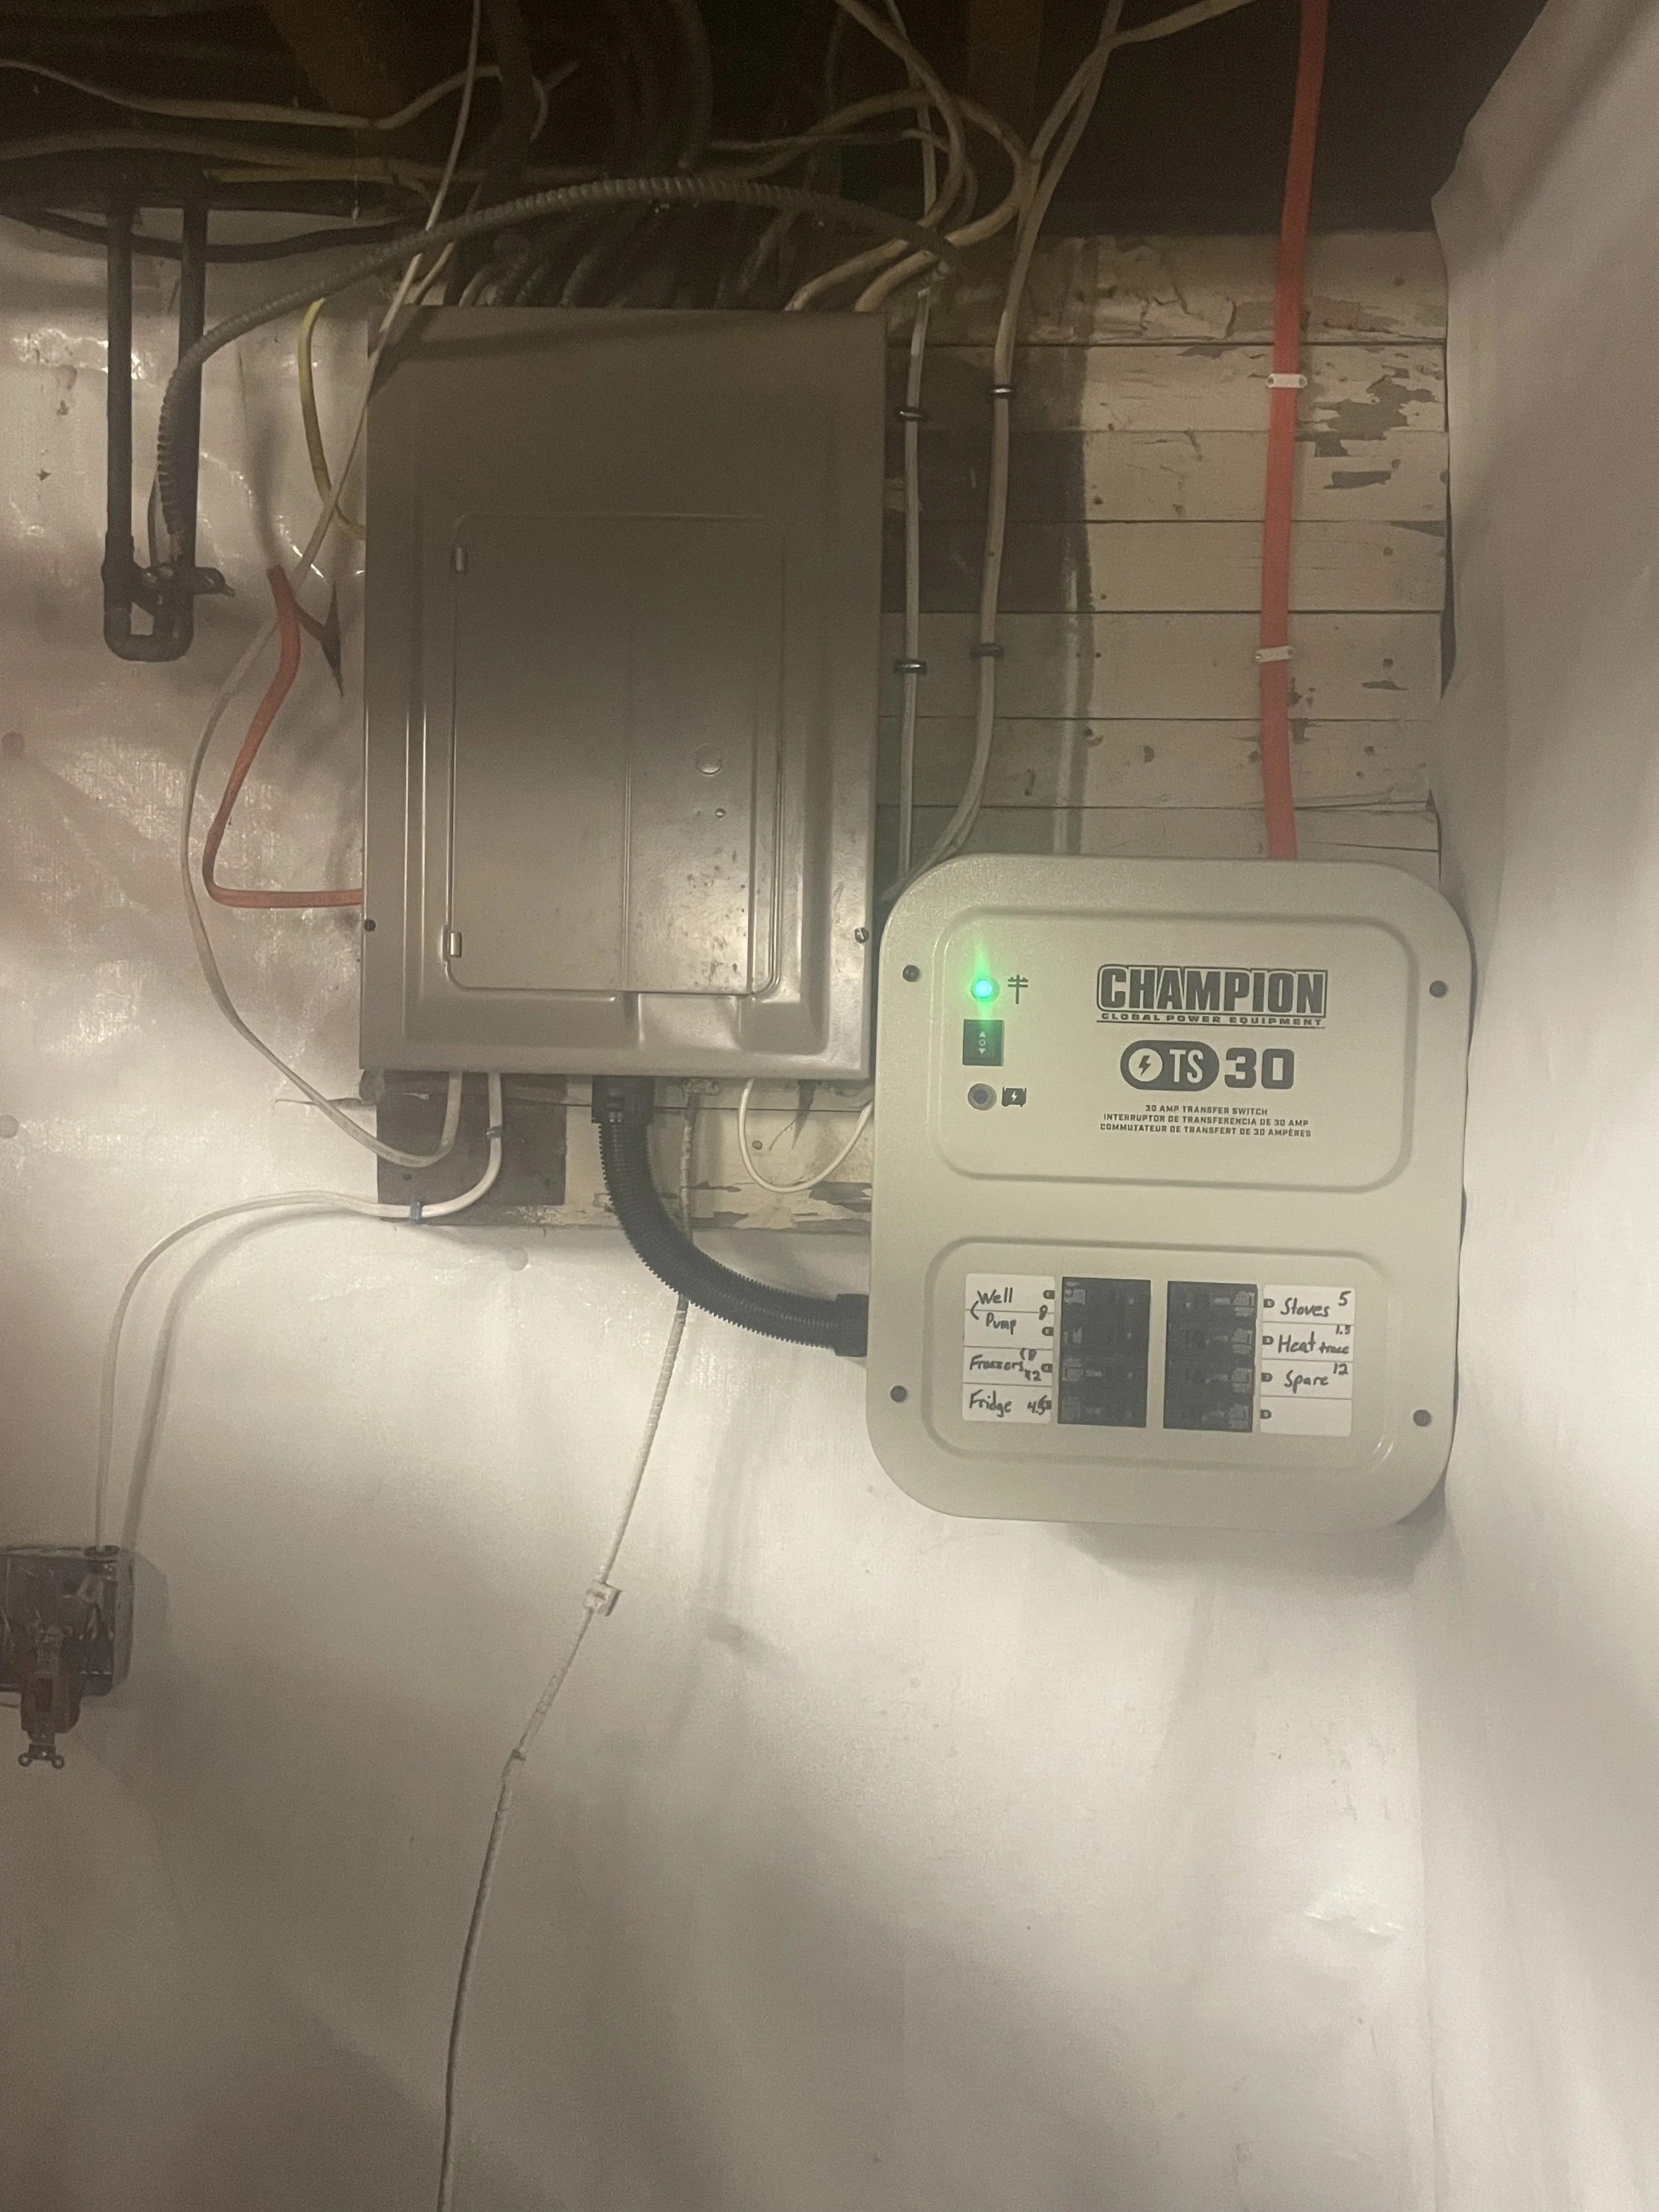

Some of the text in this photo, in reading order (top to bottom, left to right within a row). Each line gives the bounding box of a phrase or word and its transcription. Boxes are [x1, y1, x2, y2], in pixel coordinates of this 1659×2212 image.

[1099, 966, 1325, 1015] CHAMPION
[1229, 1016, 1322, 1026] EQUIPMENT
[1224, 1047, 1295, 1089] 30
[1104, 1113, 1165, 1122] INTERRUPTOR
[1182, 1116, 1257, 1126] TRANSFERENCIA
[1182, 1106, 1229, 1114] TRANSFER
[1232, 1107, 1268, 1116] SWITCH
[1100, 1123, 1167, 1133] COMMUTATEUR
[1184, 1126, 1236, 1135] TRANSFERT
[1267, 1128, 1311, 1138] AMPÈRES
[977, 1286, 1013, 1305] Well
[1338, 1290, 1352, 1306] 5
[1280, 1297, 1331, 1317] Stoves
[986, 1311, 1017, 1335] Pump
[1278, 1331, 1316, 1354] Heat
[1333, 1362, 1349, 1376] 12
[1284, 1369, 1329, 1394] Spare
[969, 1388, 1013, 1418] Fridge
